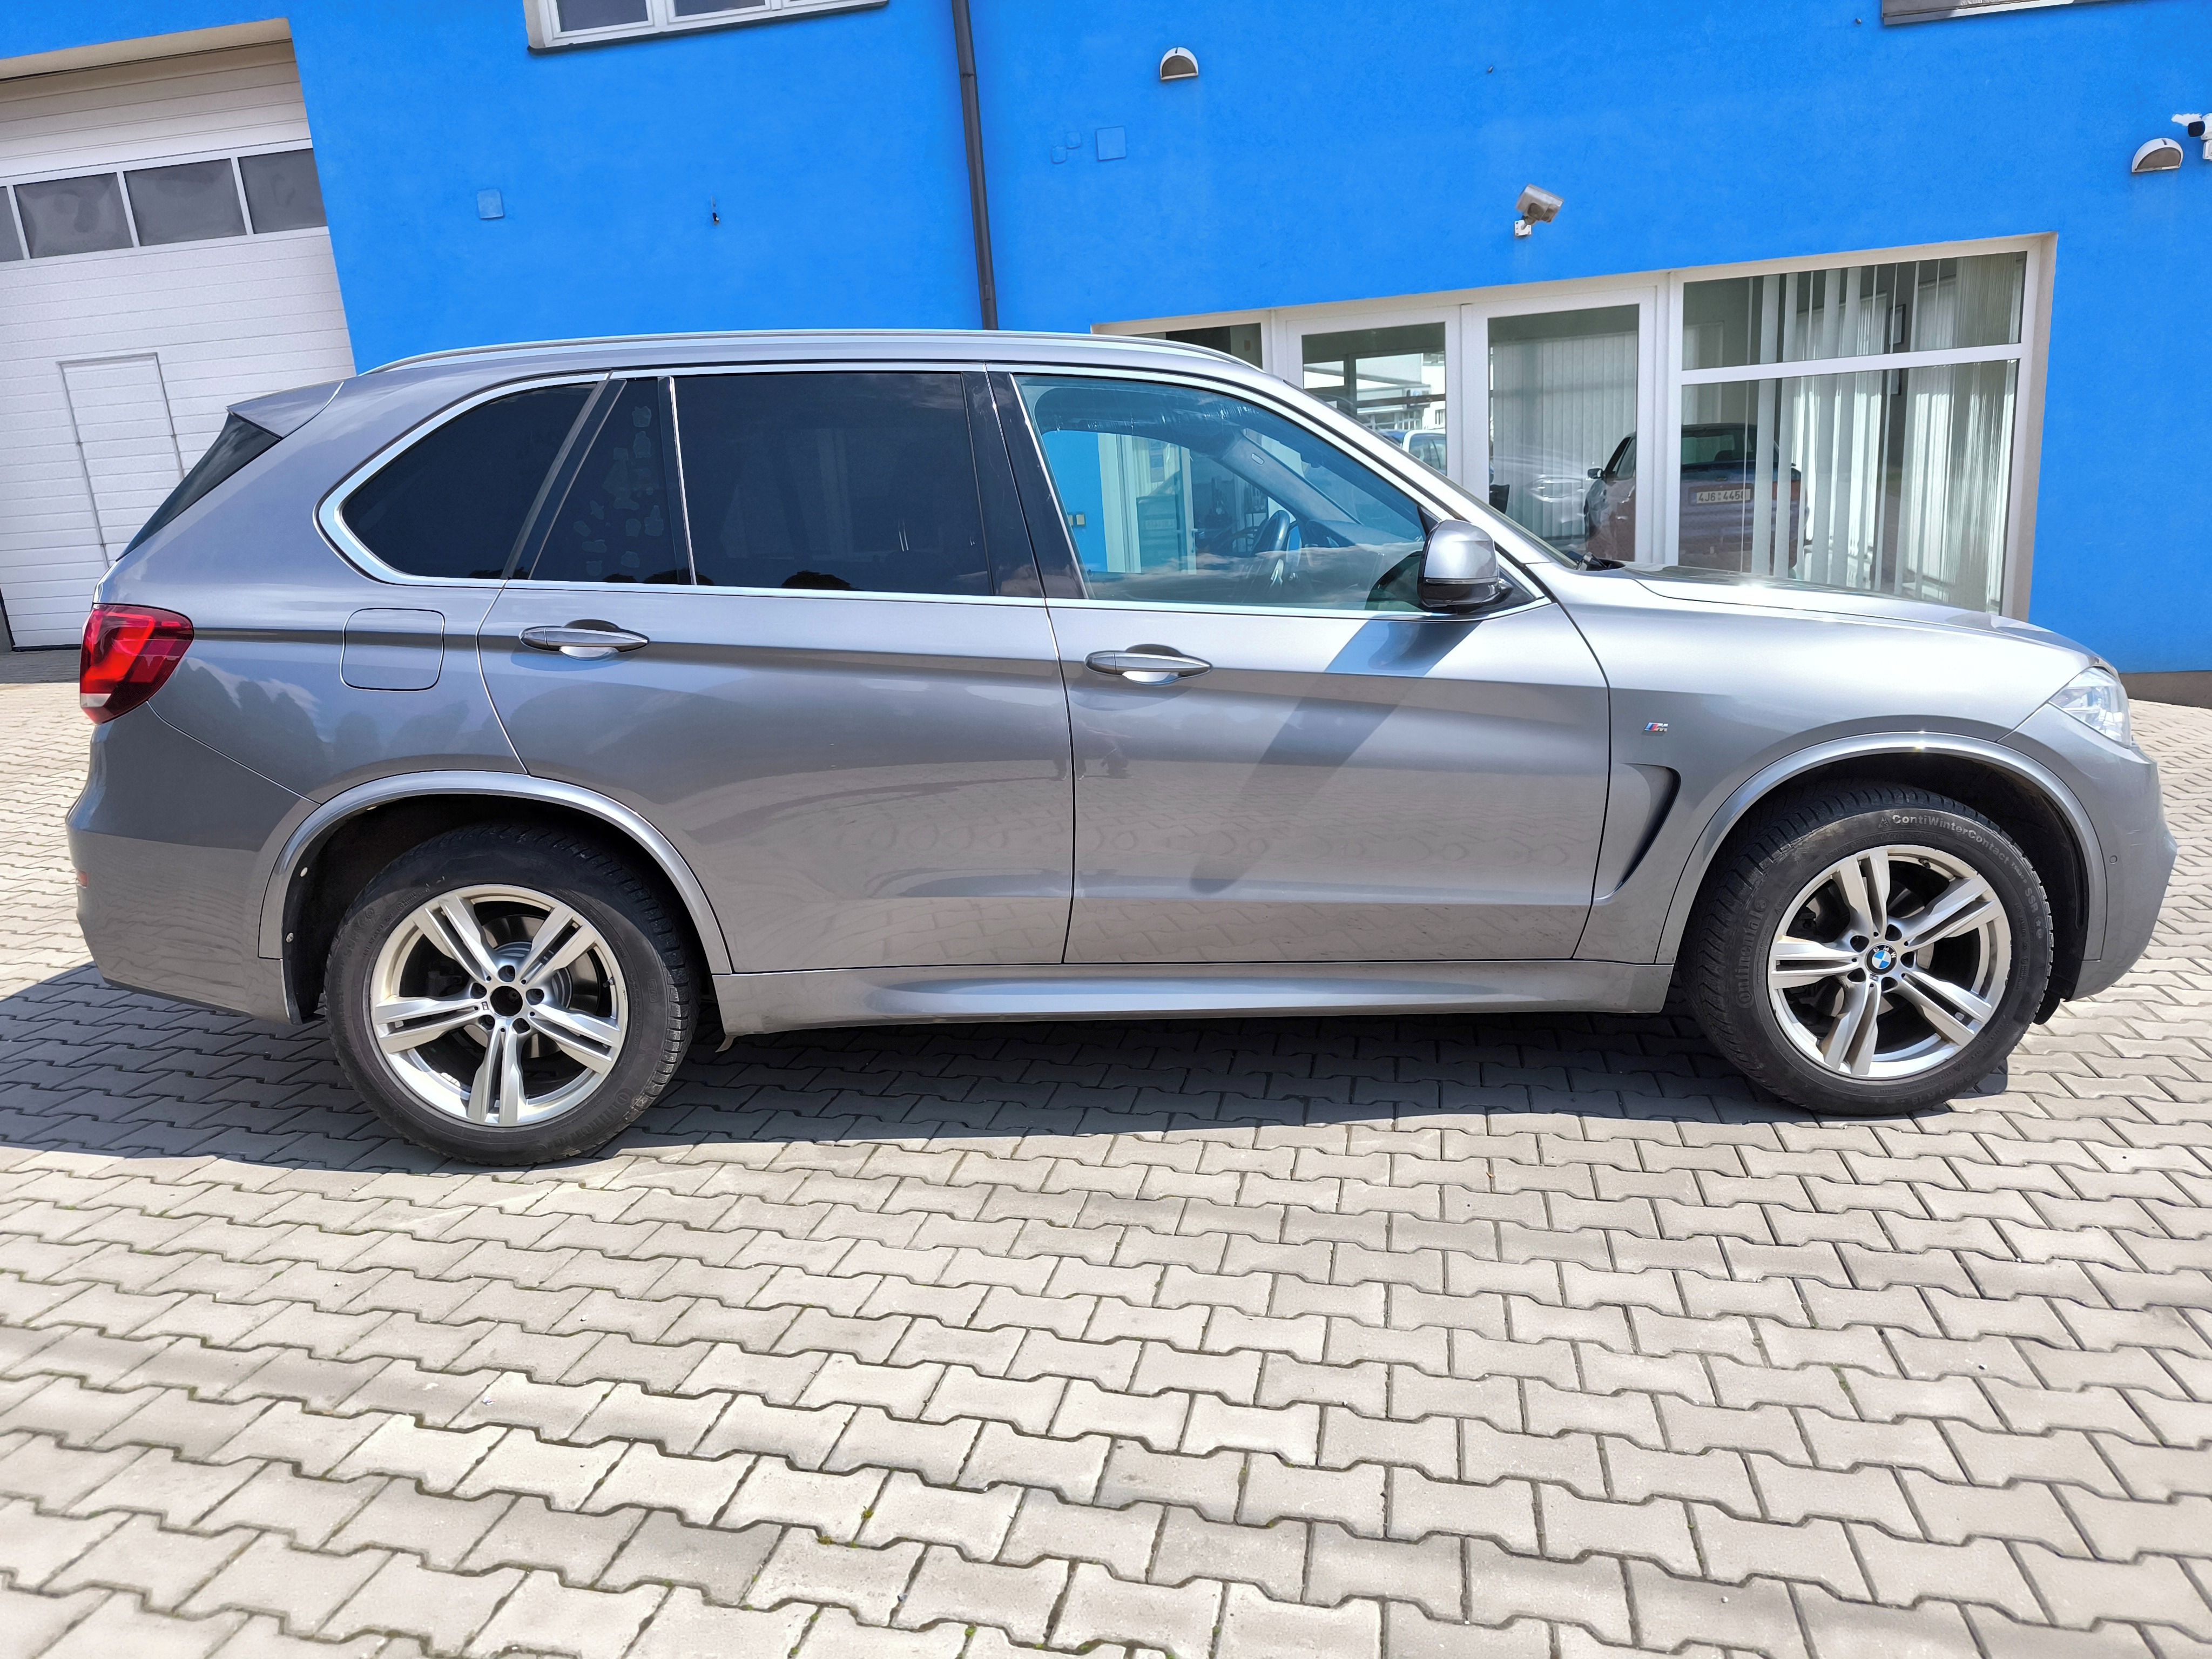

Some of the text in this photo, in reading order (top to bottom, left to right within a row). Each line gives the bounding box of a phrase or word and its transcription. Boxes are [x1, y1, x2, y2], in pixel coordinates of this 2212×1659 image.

[1698, 492, 1716, 502] 4J6
[1892, 814, 2009, 864] ContiWinterContact
[2025, 887, 2039, 913] SSR
[1873, 946, 1896, 959] BMW
